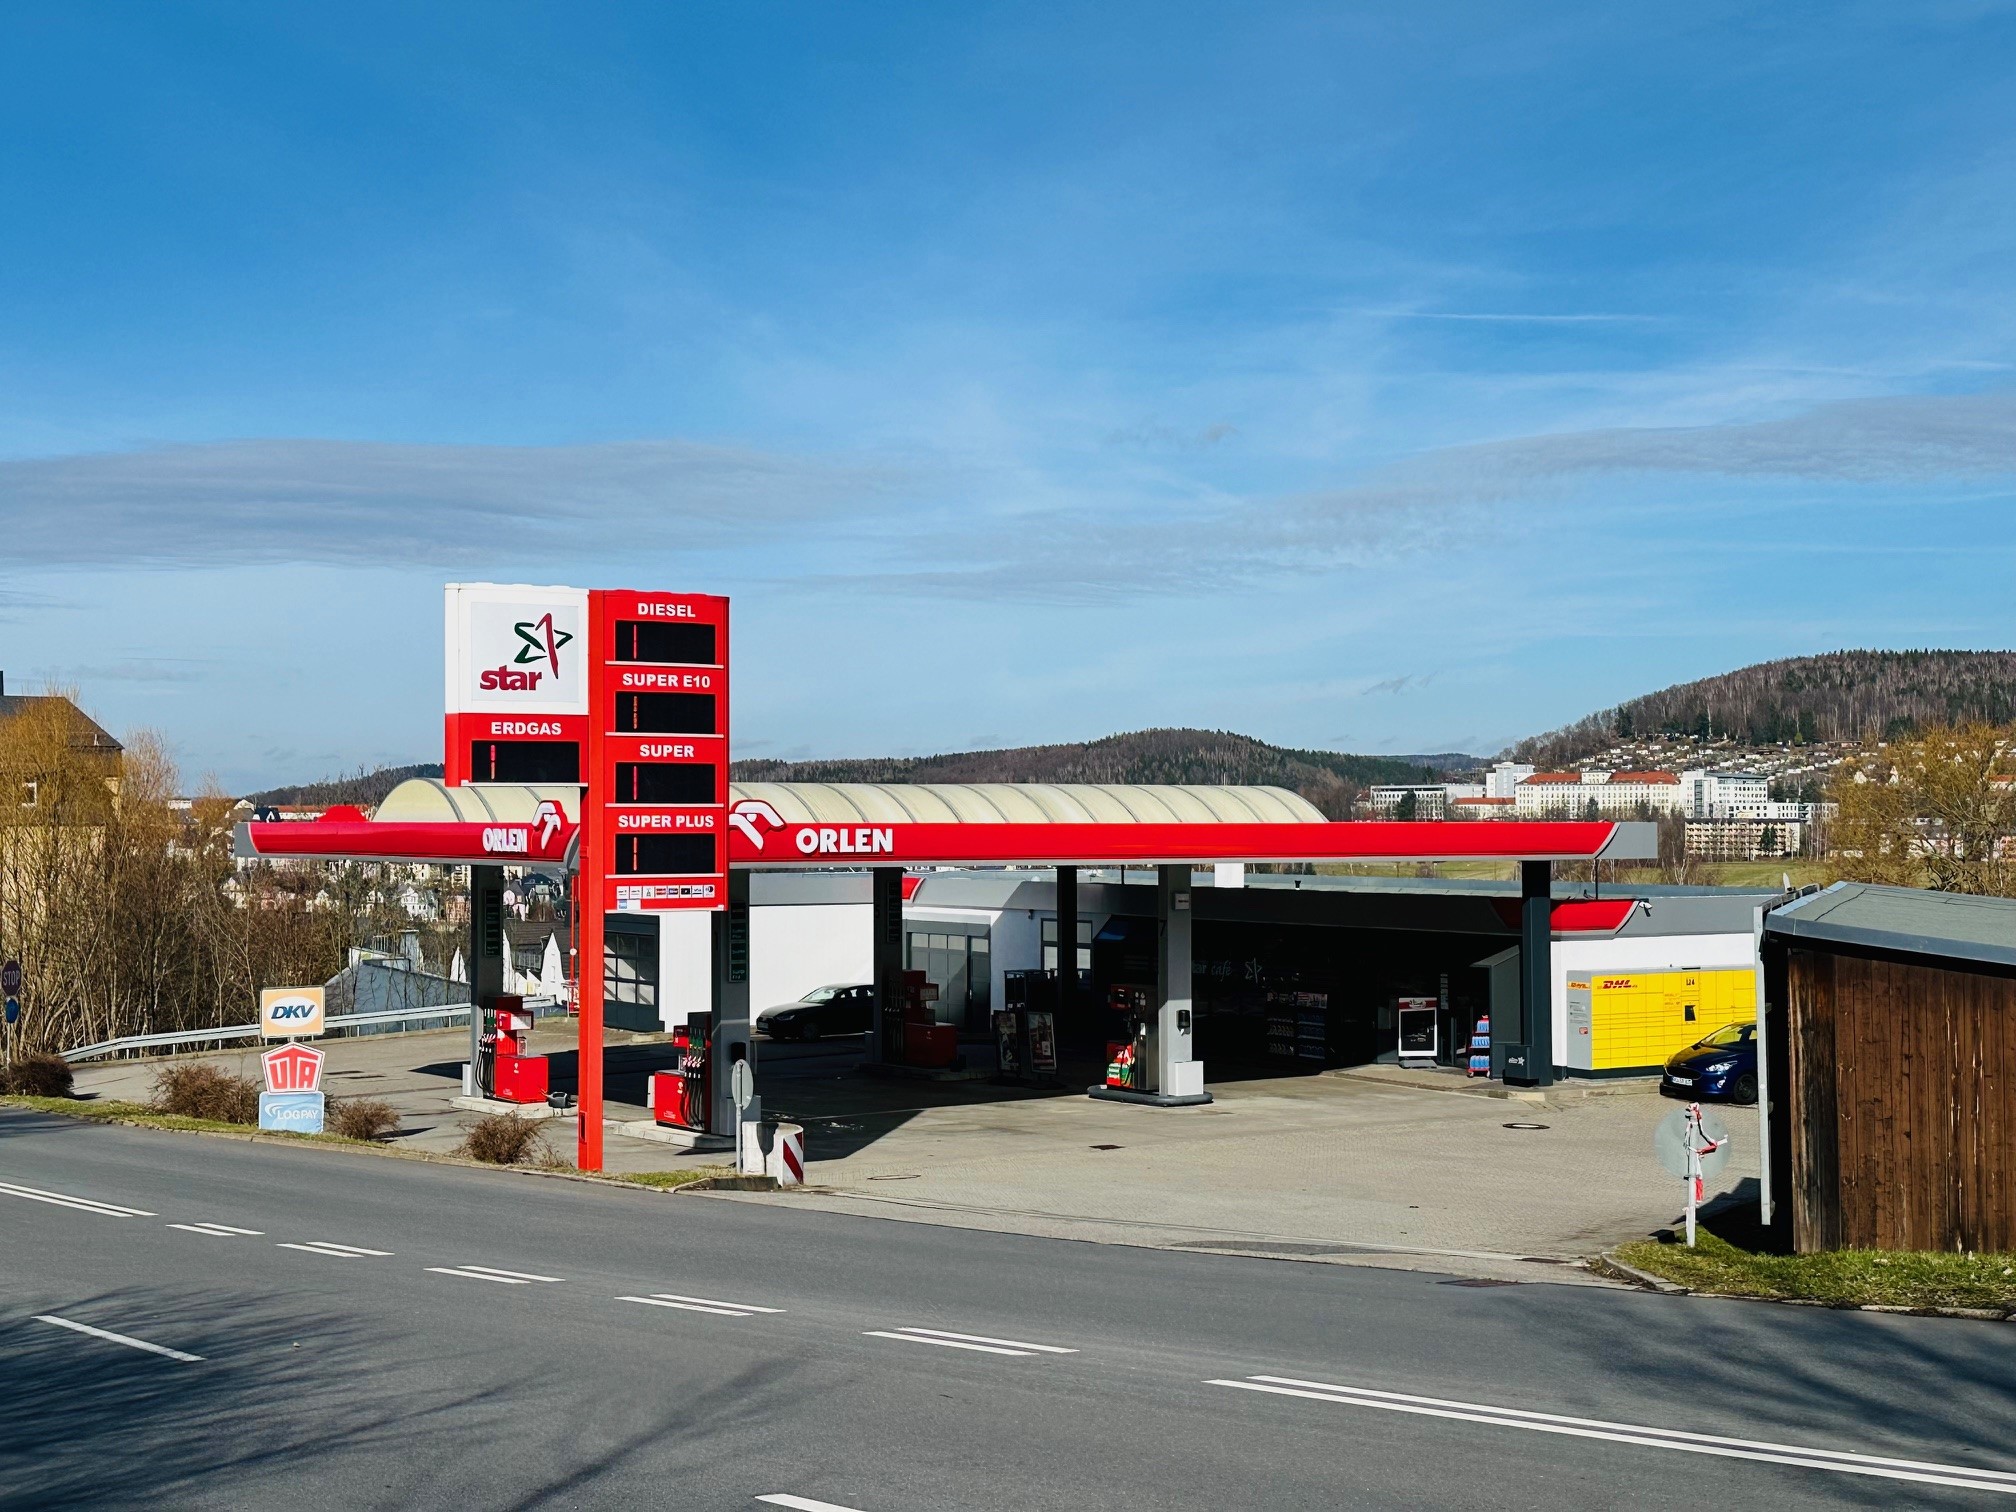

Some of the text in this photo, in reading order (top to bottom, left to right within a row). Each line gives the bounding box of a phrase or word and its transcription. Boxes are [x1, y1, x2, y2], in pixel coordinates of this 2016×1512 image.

[638, 602, 695, 617] DIESEL
[479, 666, 542, 690] star
[622, 673, 711, 688] SUPER E10
[491, 721, 562, 736] ERDGAS
[640, 743, 694, 757] SUPER
[618, 814, 714, 828] SUPER PLUS
[482, 828, 527, 853] ORLEN
[796, 828, 893, 854] ORLEN
[3, 971, 20, 985] STOP
[1602, 980, 1632, 989] DHL
[271, 1005, 315, 1019] DKV
[268, 1048, 318, 1089] UTA
[277, 1110, 318, 1121] LOGPAY
